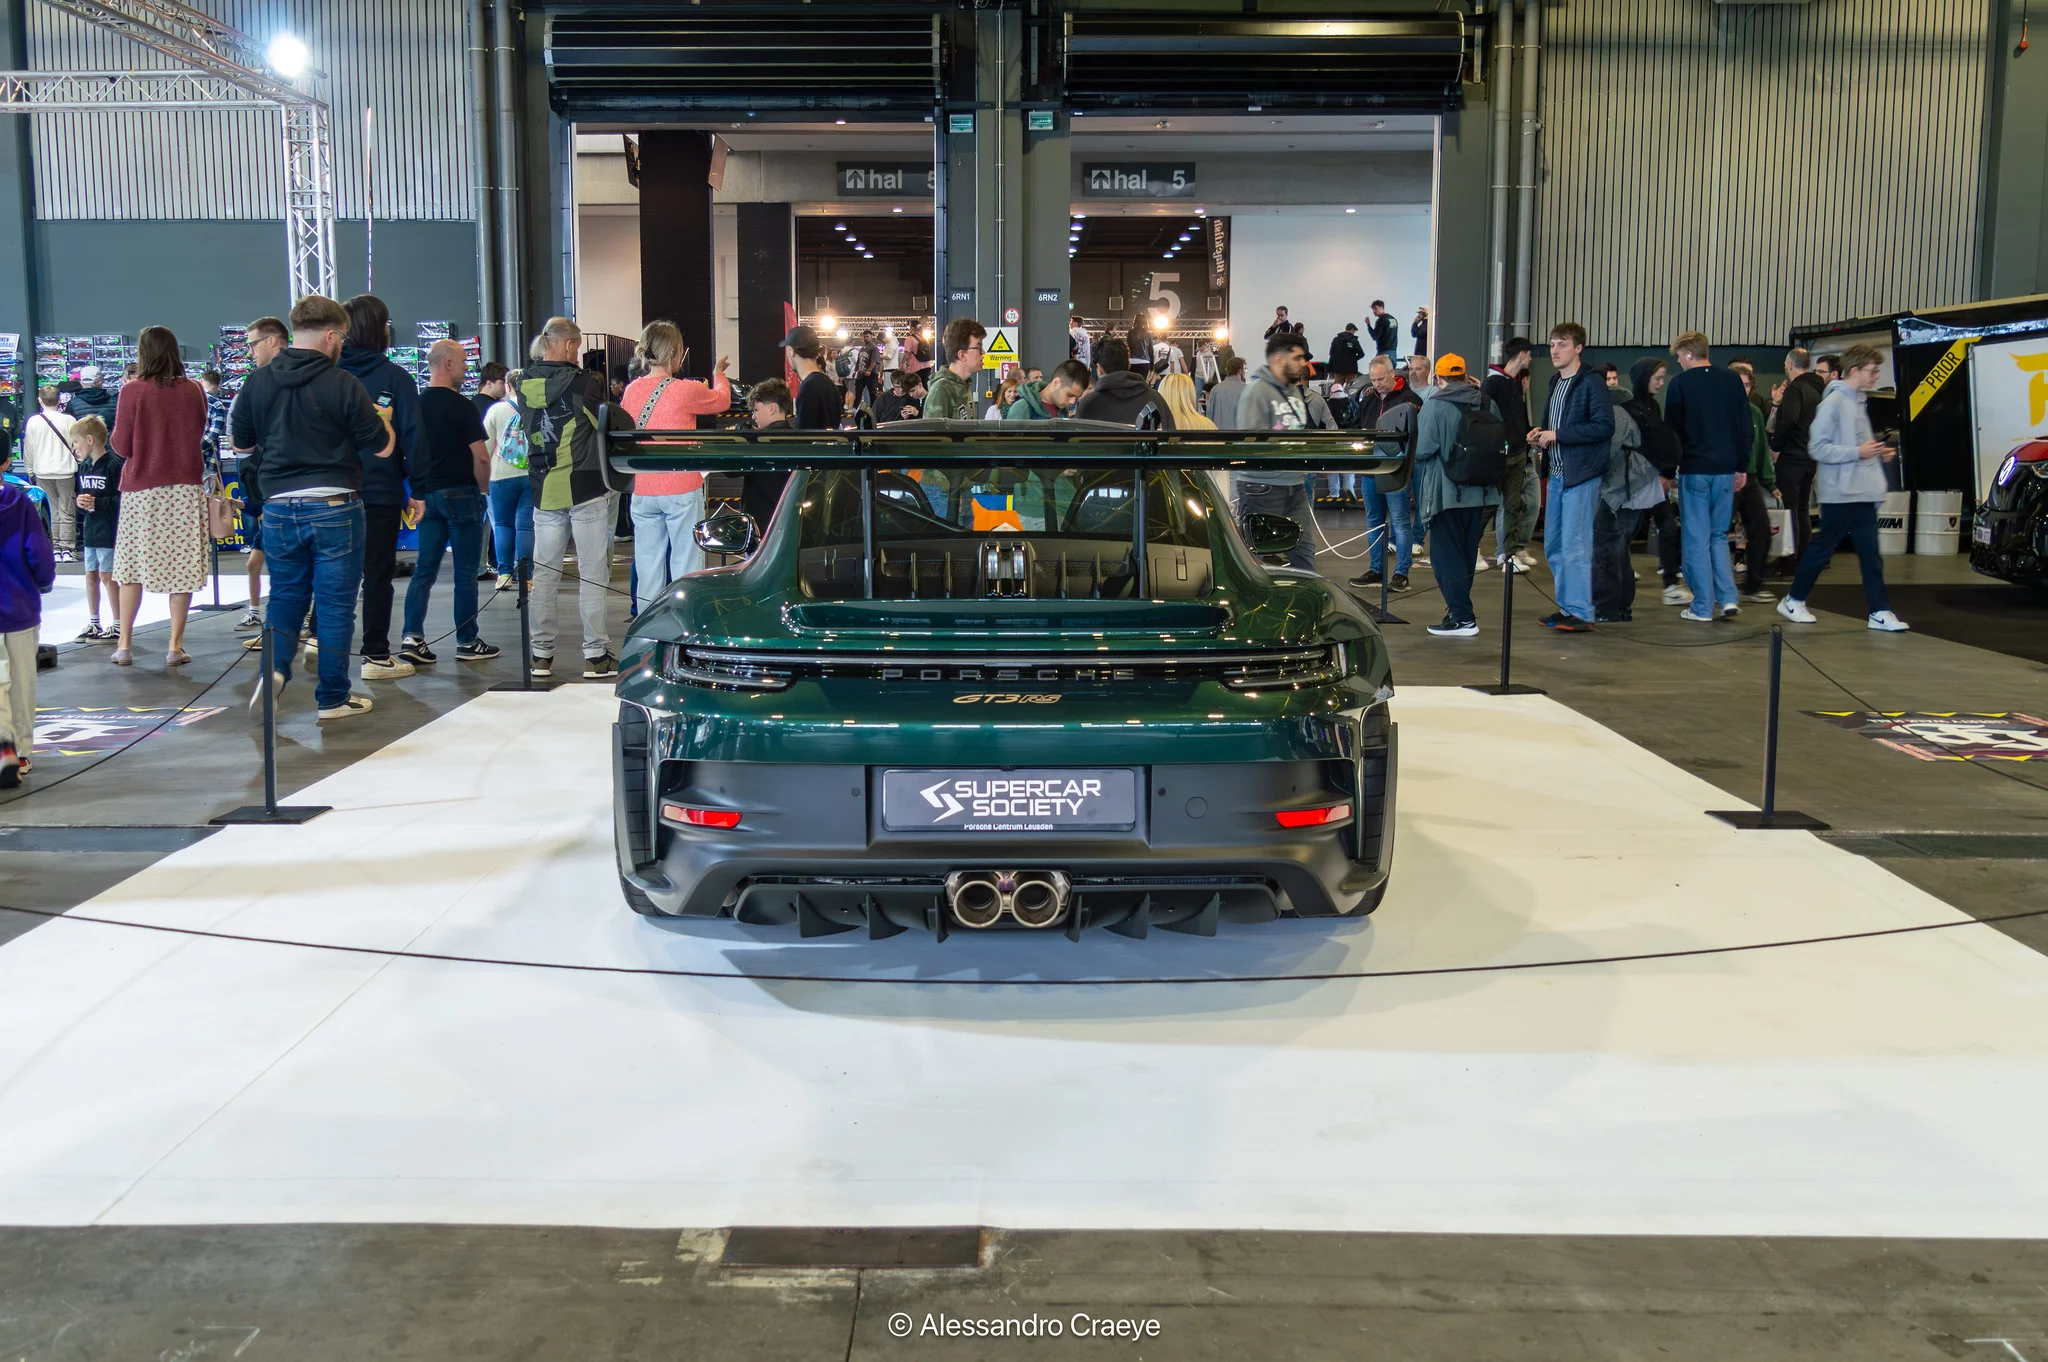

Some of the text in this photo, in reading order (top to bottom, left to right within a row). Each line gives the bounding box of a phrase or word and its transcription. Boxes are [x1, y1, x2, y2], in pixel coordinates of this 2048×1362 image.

[869, 169, 935, 190] hal 5
[1114, 169, 1185, 190] hal 5
[951, 293, 970, 301] 6RN1
[1038, 293, 1058, 302] 6RN2
[1147, 272, 1181, 323] 5
[989, 354, 1012, 362] Warning
[1924, 351, 1961, 390] PRIOR
[80, 475, 107, 490] VANS
[881, 668, 1135, 681] PORSCHE
[954, 779, 1101, 798] SUPERCAR
[972, 798, 1084, 817] SOCIETY
[1024, 823, 1054, 831] Leusden
